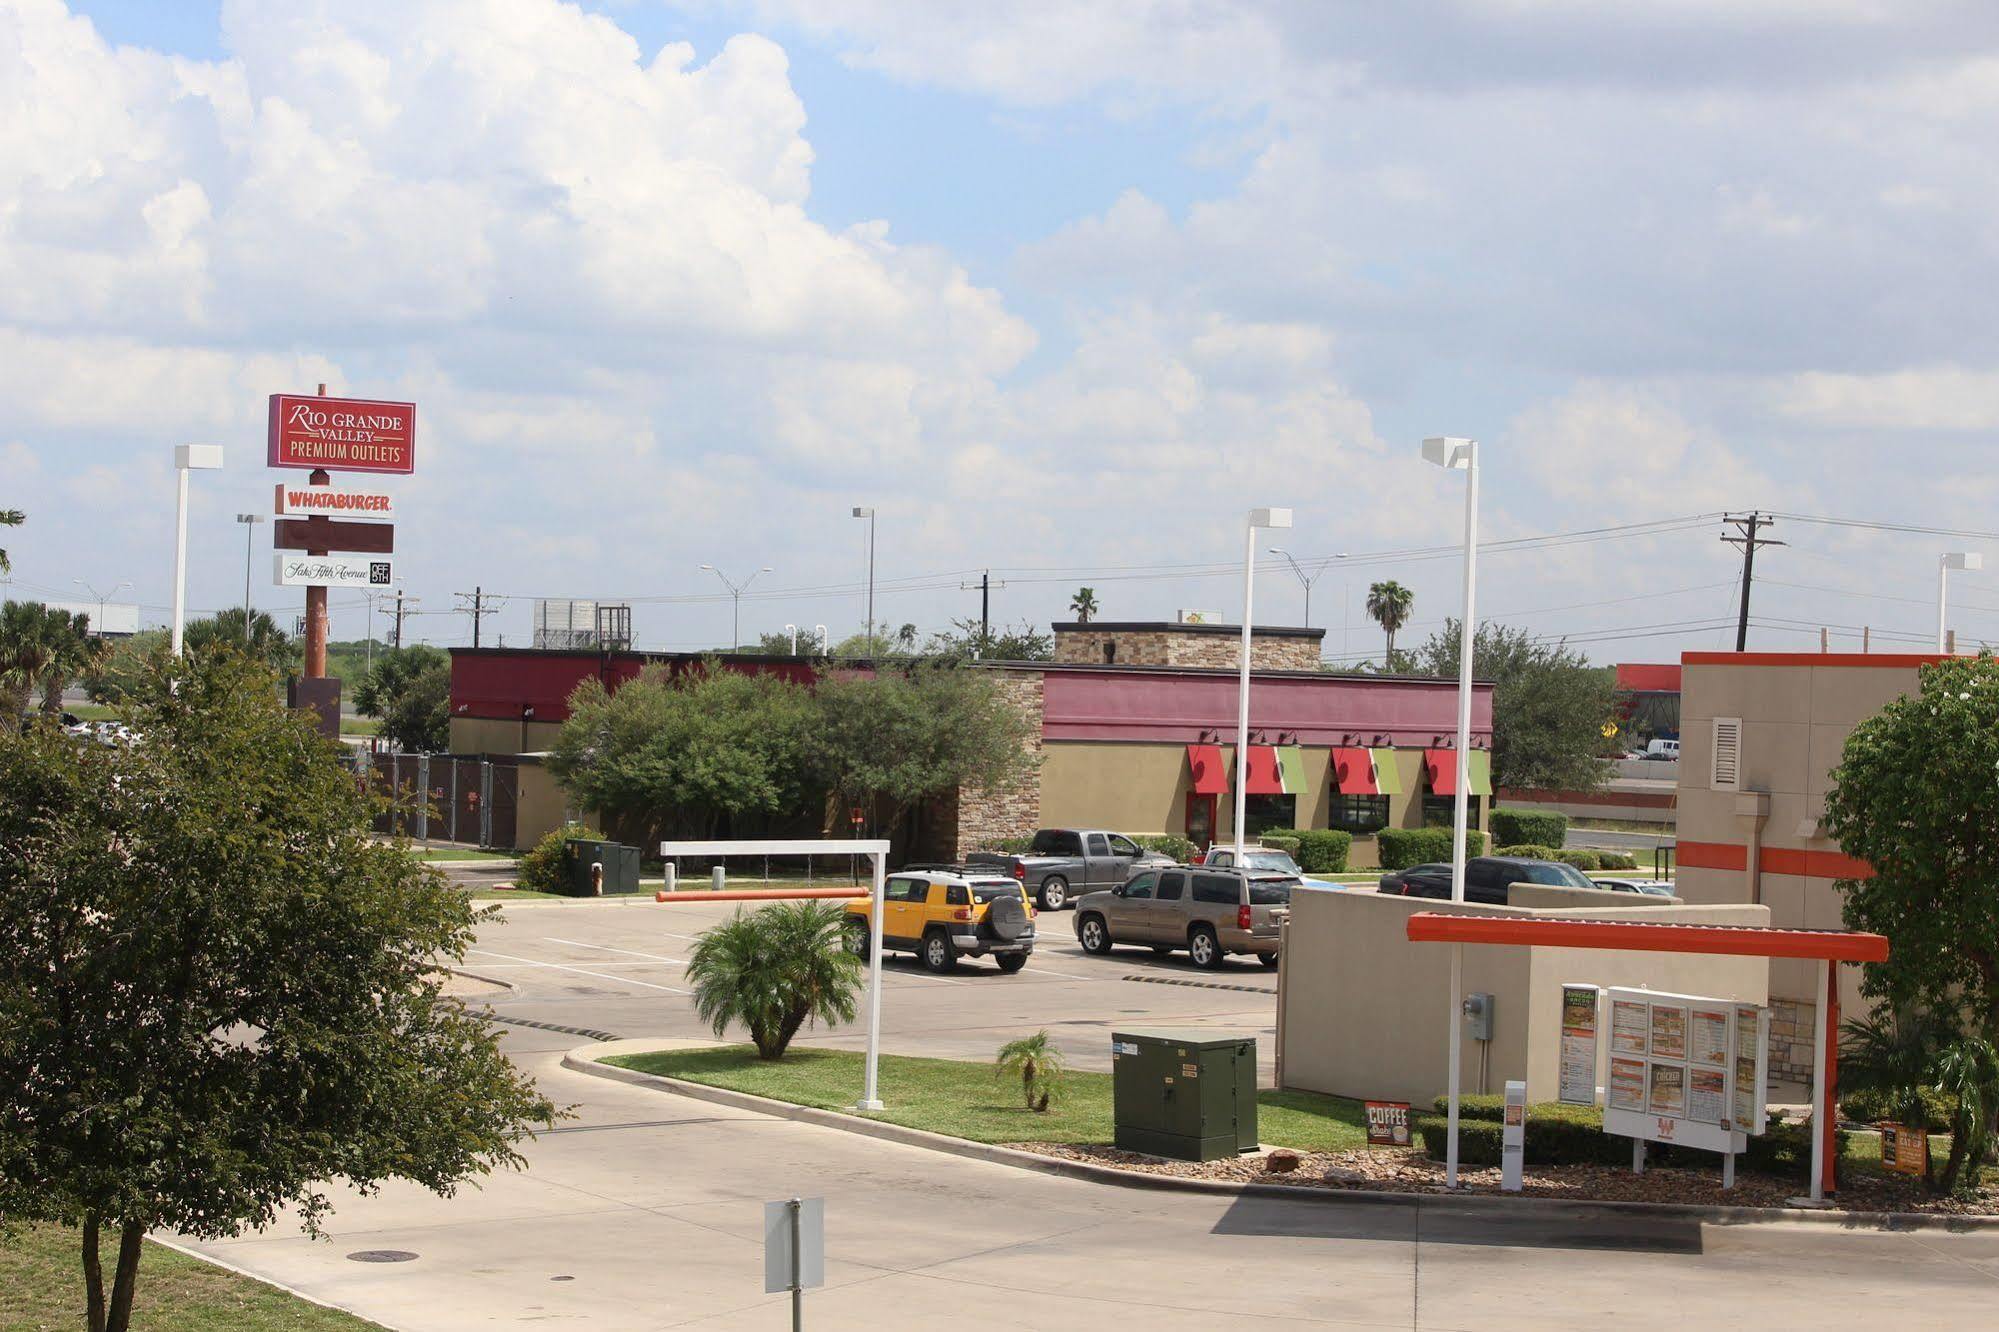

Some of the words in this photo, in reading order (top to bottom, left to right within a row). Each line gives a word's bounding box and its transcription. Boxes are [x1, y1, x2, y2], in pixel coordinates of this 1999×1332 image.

[332, 413, 403, 431] GRANDE
[318, 428, 375, 443] VALLEY
[290, 441, 347, 460] PREMIUM
[350, 445, 401, 463] OUTLETS
[288, 491, 390, 511] WHATABURGER
[284, 562, 312, 579] Saks
[311, 563, 334, 579] Fifth
[332, 563, 368, 580] Avenue
[371, 564, 389, 574] OFF
[371, 573, 389, 583] 5TH
[1368, 1107, 1407, 1126] COFFEE
